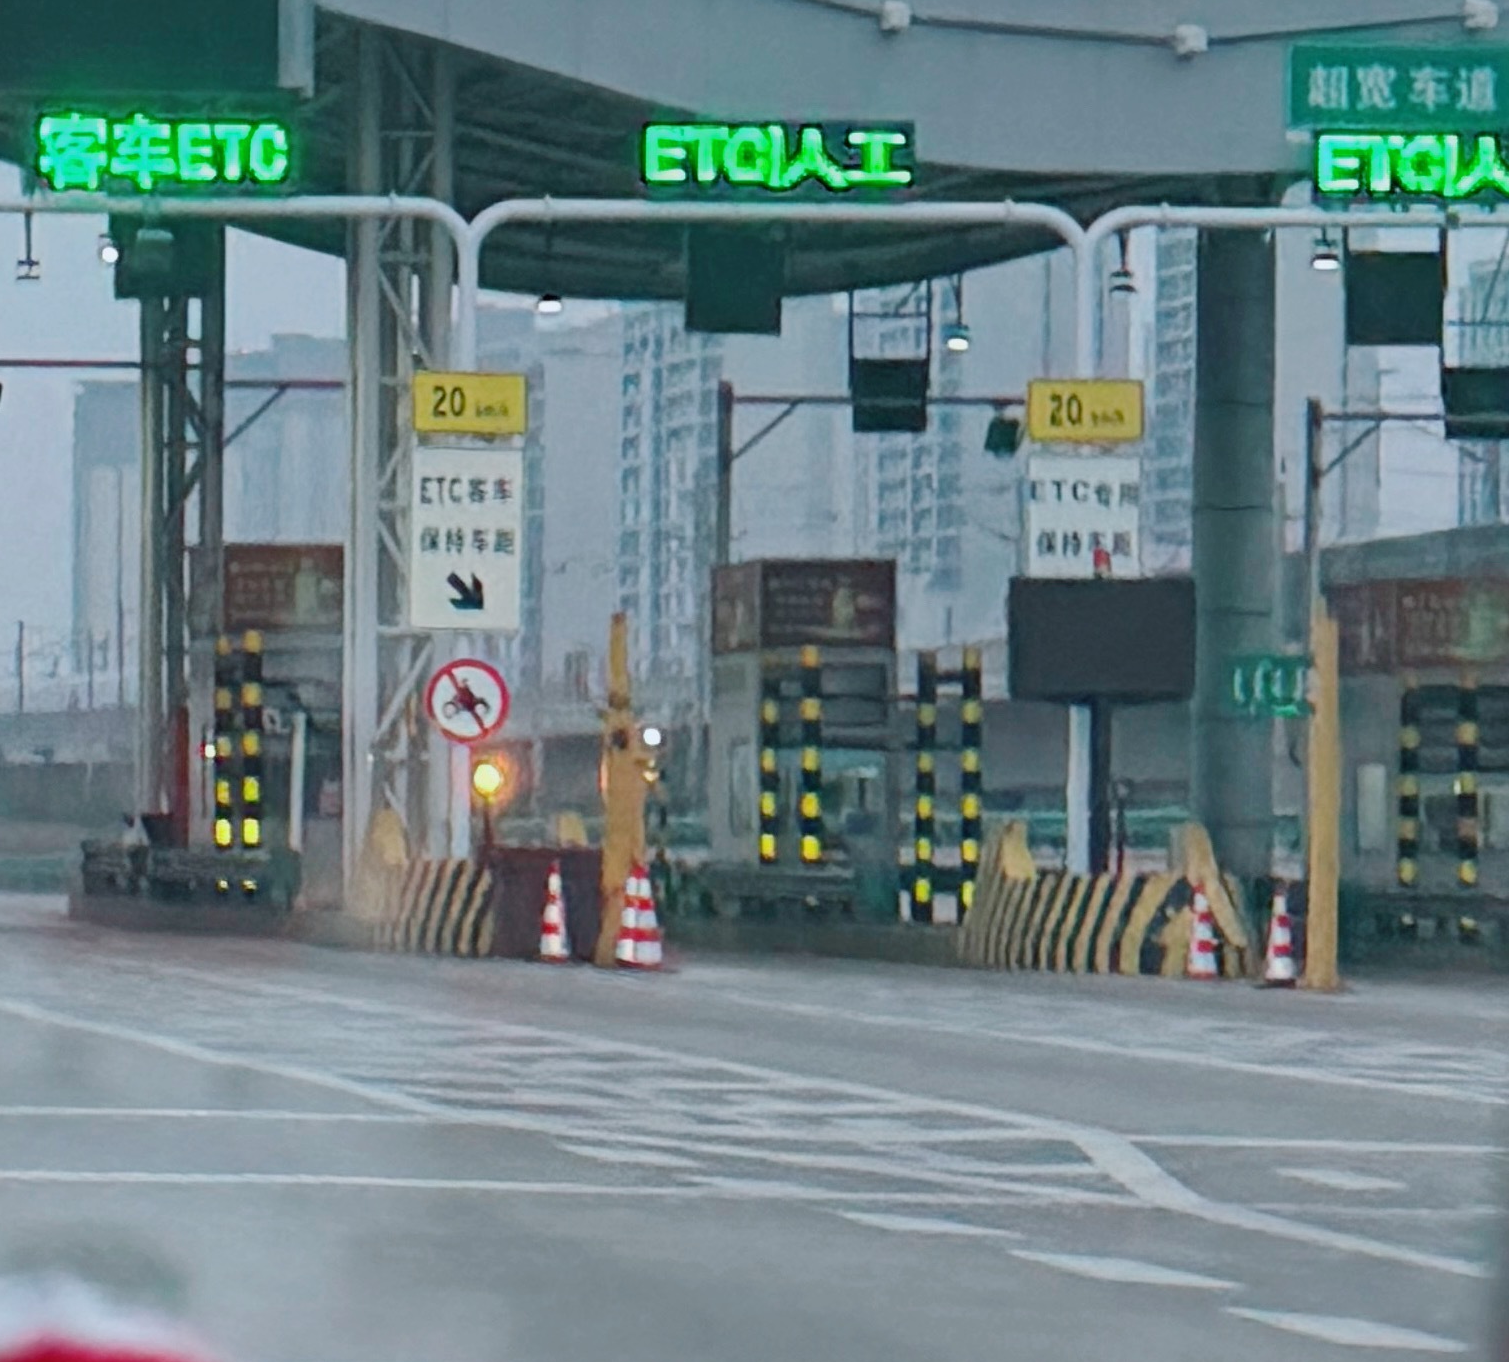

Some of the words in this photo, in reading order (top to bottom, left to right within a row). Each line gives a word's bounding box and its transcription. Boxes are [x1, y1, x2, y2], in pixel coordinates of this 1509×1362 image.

[39, 112, 288, 190] 客车ETC
[431, 384, 467, 418] 20
[1048, 392, 1083, 427] 20
